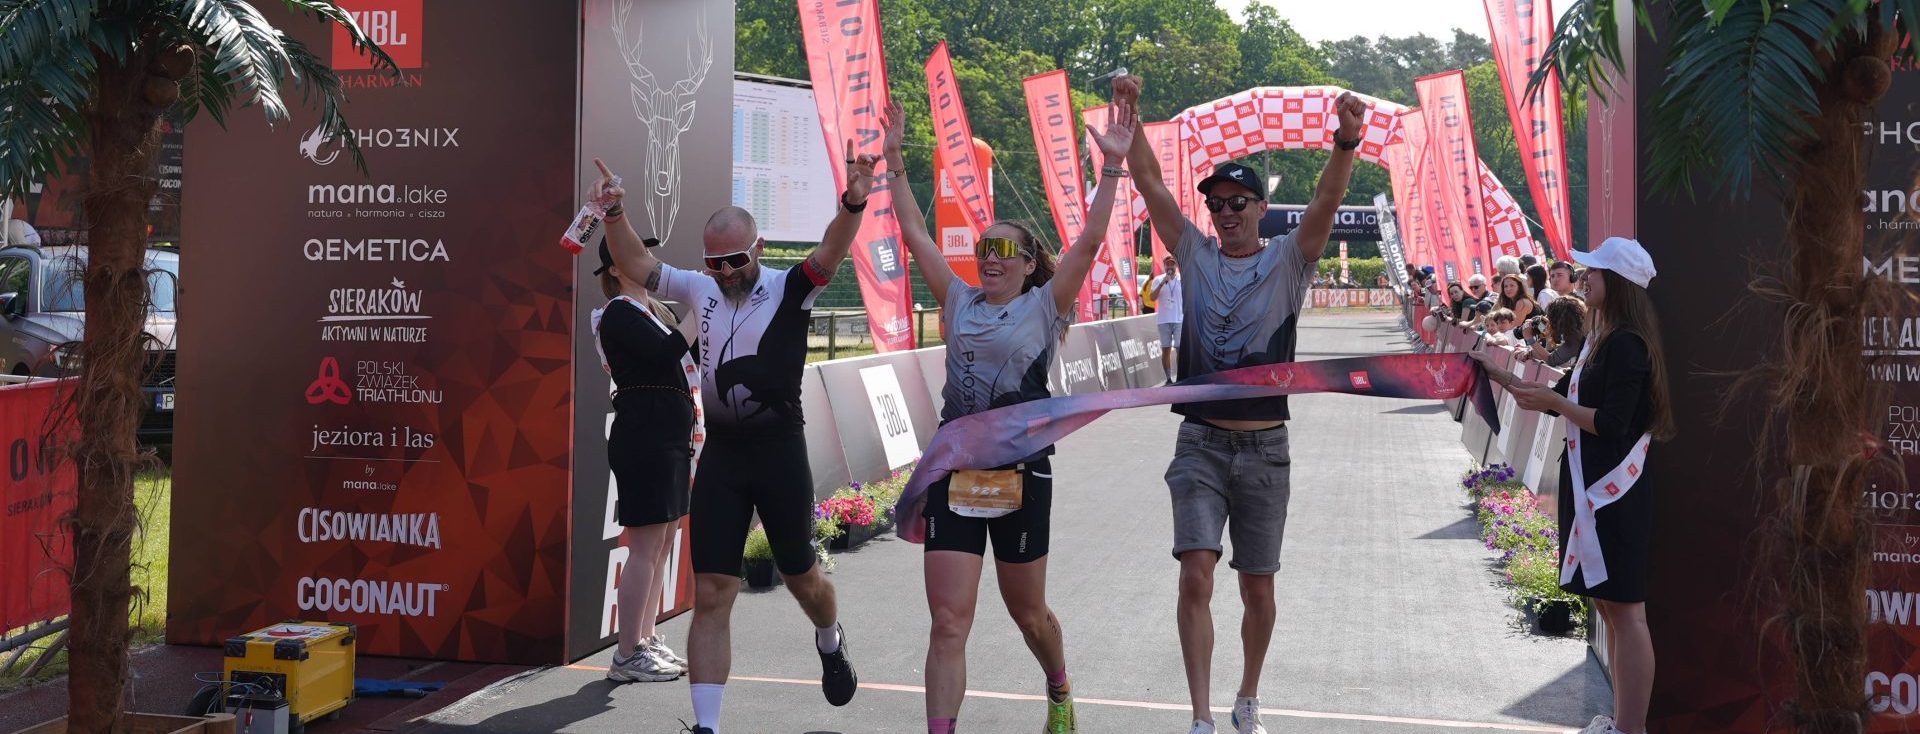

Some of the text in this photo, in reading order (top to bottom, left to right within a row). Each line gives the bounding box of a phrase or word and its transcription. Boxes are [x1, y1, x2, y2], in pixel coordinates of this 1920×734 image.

[341, 75, 422, 88] HARMAN
[1238, 105, 1252, 114] JBL
[1287, 101, 1300, 110] JBL
[1266, 116, 1280, 126] JBL
[1306, 117, 1320, 126] JBL
[1375, 115, 1388, 124] JBL
[1224, 126, 1238, 135] JBL
[1287, 132, 1300, 140] JBL
[308, 208, 446, 218] natura harmonia cisza
[948, 235, 968, 248] JBL
[303, 238, 450, 262] QEMETICA
[321, 325, 427, 342] AKTYWNI W NATURZE
[357, 360, 404, 375] POLSKI
[356, 388, 443, 404] TRIATHLONU
[877, 394, 908, 438] JBL
[311, 424, 434, 452] jeziora i las
[365, 464, 376, 477] by
[970, 486, 1001, 496] 922
[297, 507, 442, 550] CISOWIANKA
